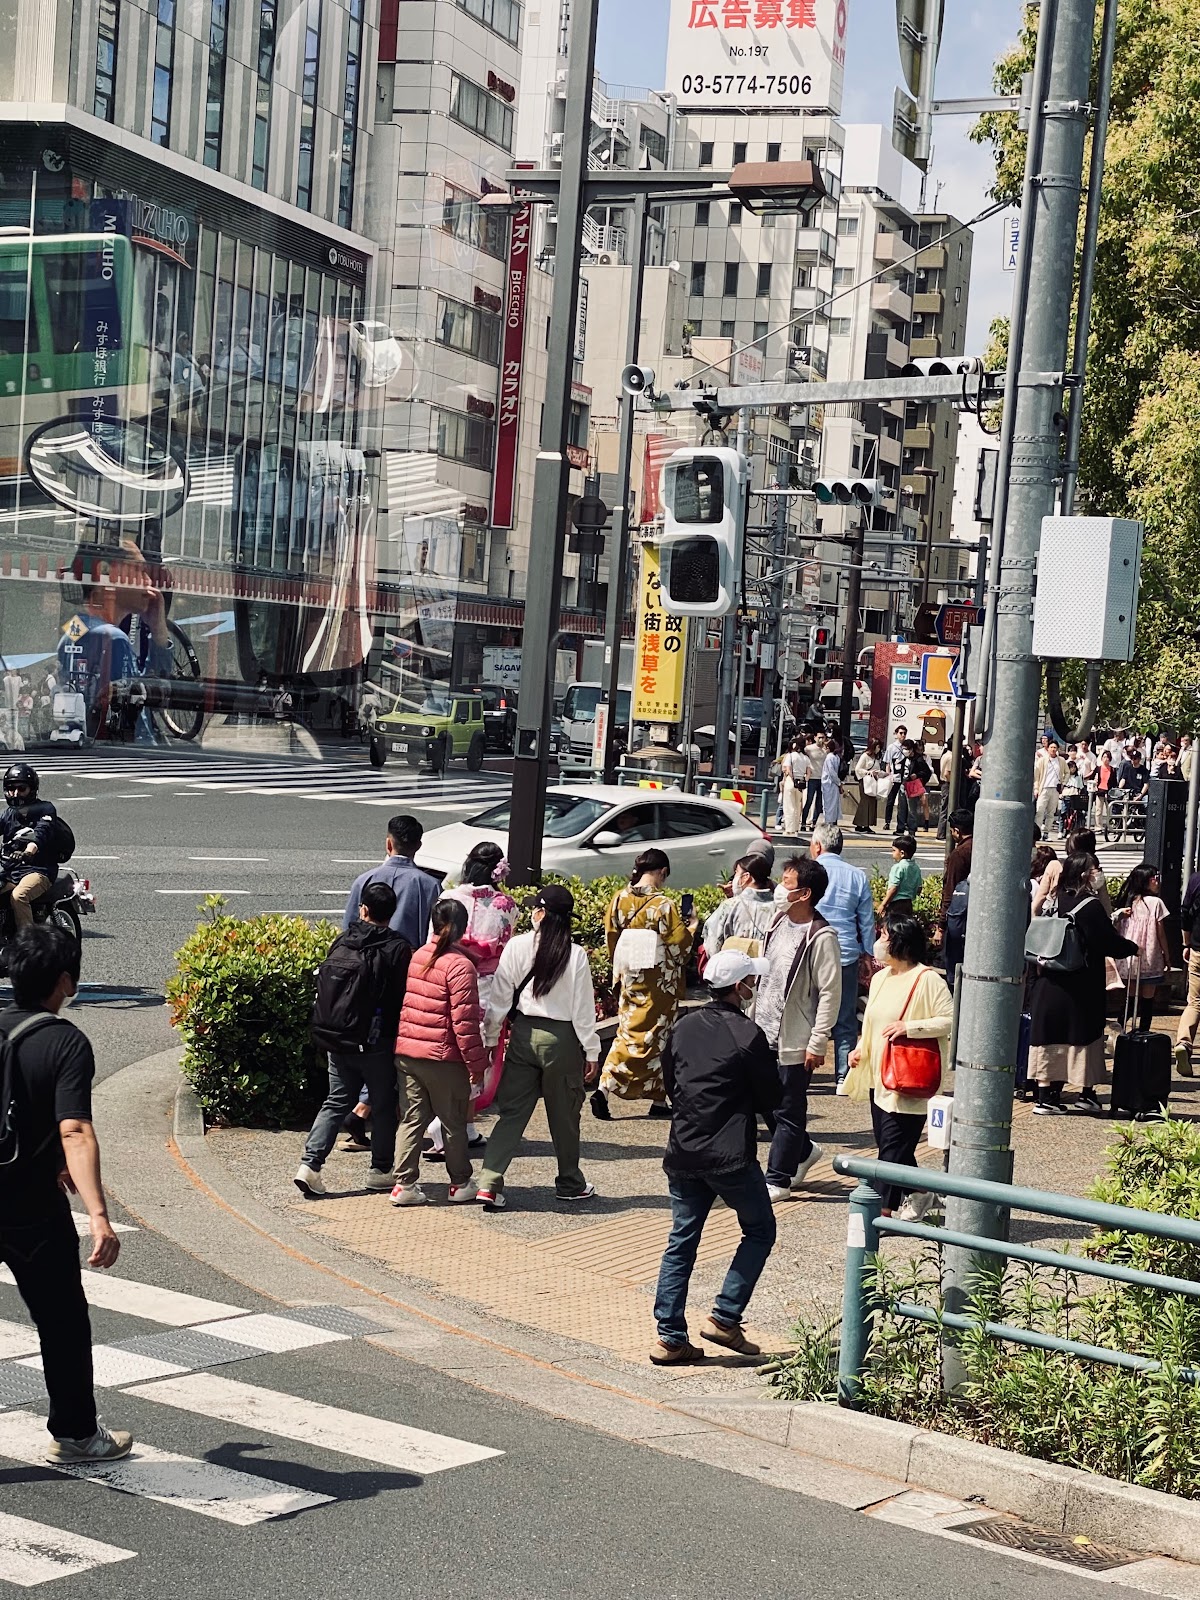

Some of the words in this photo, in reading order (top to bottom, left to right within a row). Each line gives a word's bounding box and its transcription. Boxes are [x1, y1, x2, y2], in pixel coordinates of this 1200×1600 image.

[688, 0, 817, 29] 広告募集
[729, 46, 769, 57] No.197
[682, 74, 812, 95] 03-5774-7506
[337, 253, 350, 268] TOBU
[350, 258, 364, 274] HOTEL
[510, 270, 522, 293] BIG
[507, 295, 520, 328] ECHO
[93, 320, 109, 386] みずほ銀行
[500, 360, 520, 427] カラオケ
